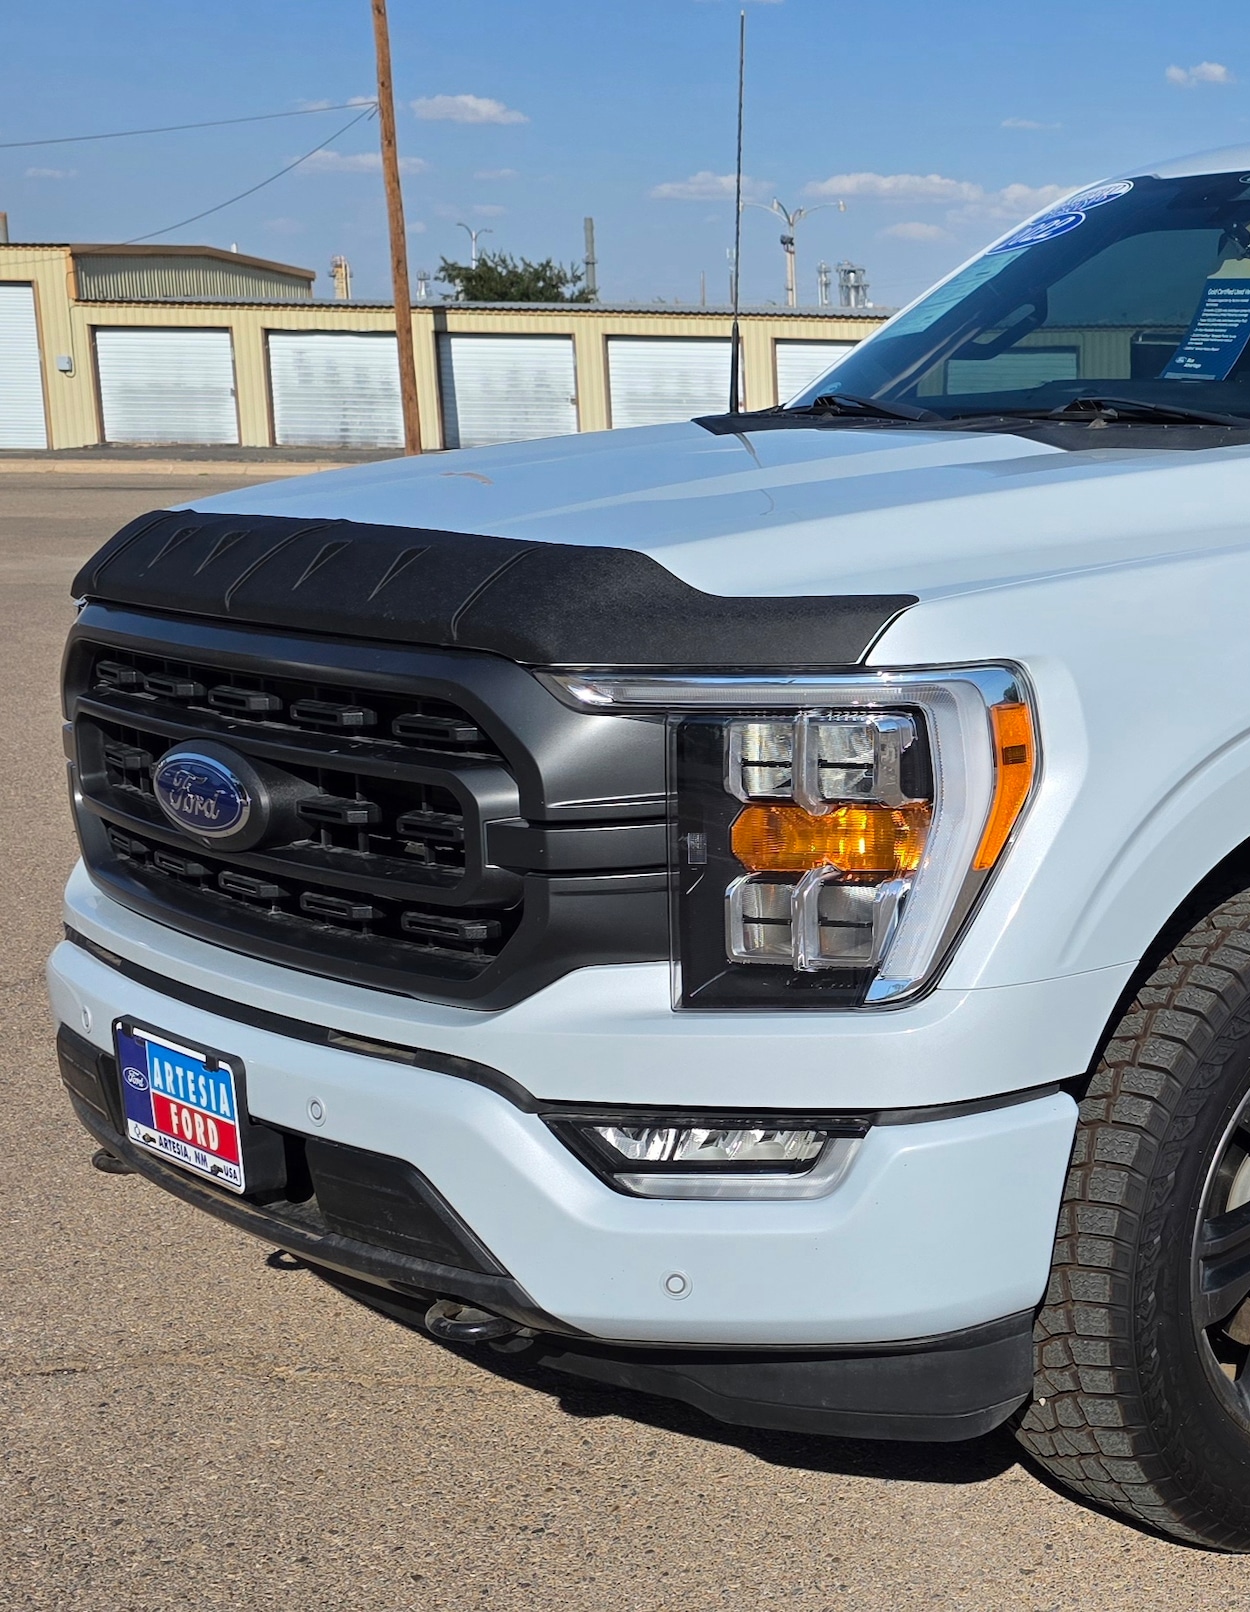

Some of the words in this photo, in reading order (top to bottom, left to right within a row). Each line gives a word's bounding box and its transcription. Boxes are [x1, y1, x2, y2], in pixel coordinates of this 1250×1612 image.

[169, 769, 226, 820] Ford
[127, 1069, 145, 1088] Ford
[153, 1057, 231, 1117] ARTESIA
[170, 1103, 219, 1151] FORD
[158, 1135, 192, 1162] ARTESIA,
[194, 1150, 208, 1167] NM
[224, 1165, 239, 1181] USA
